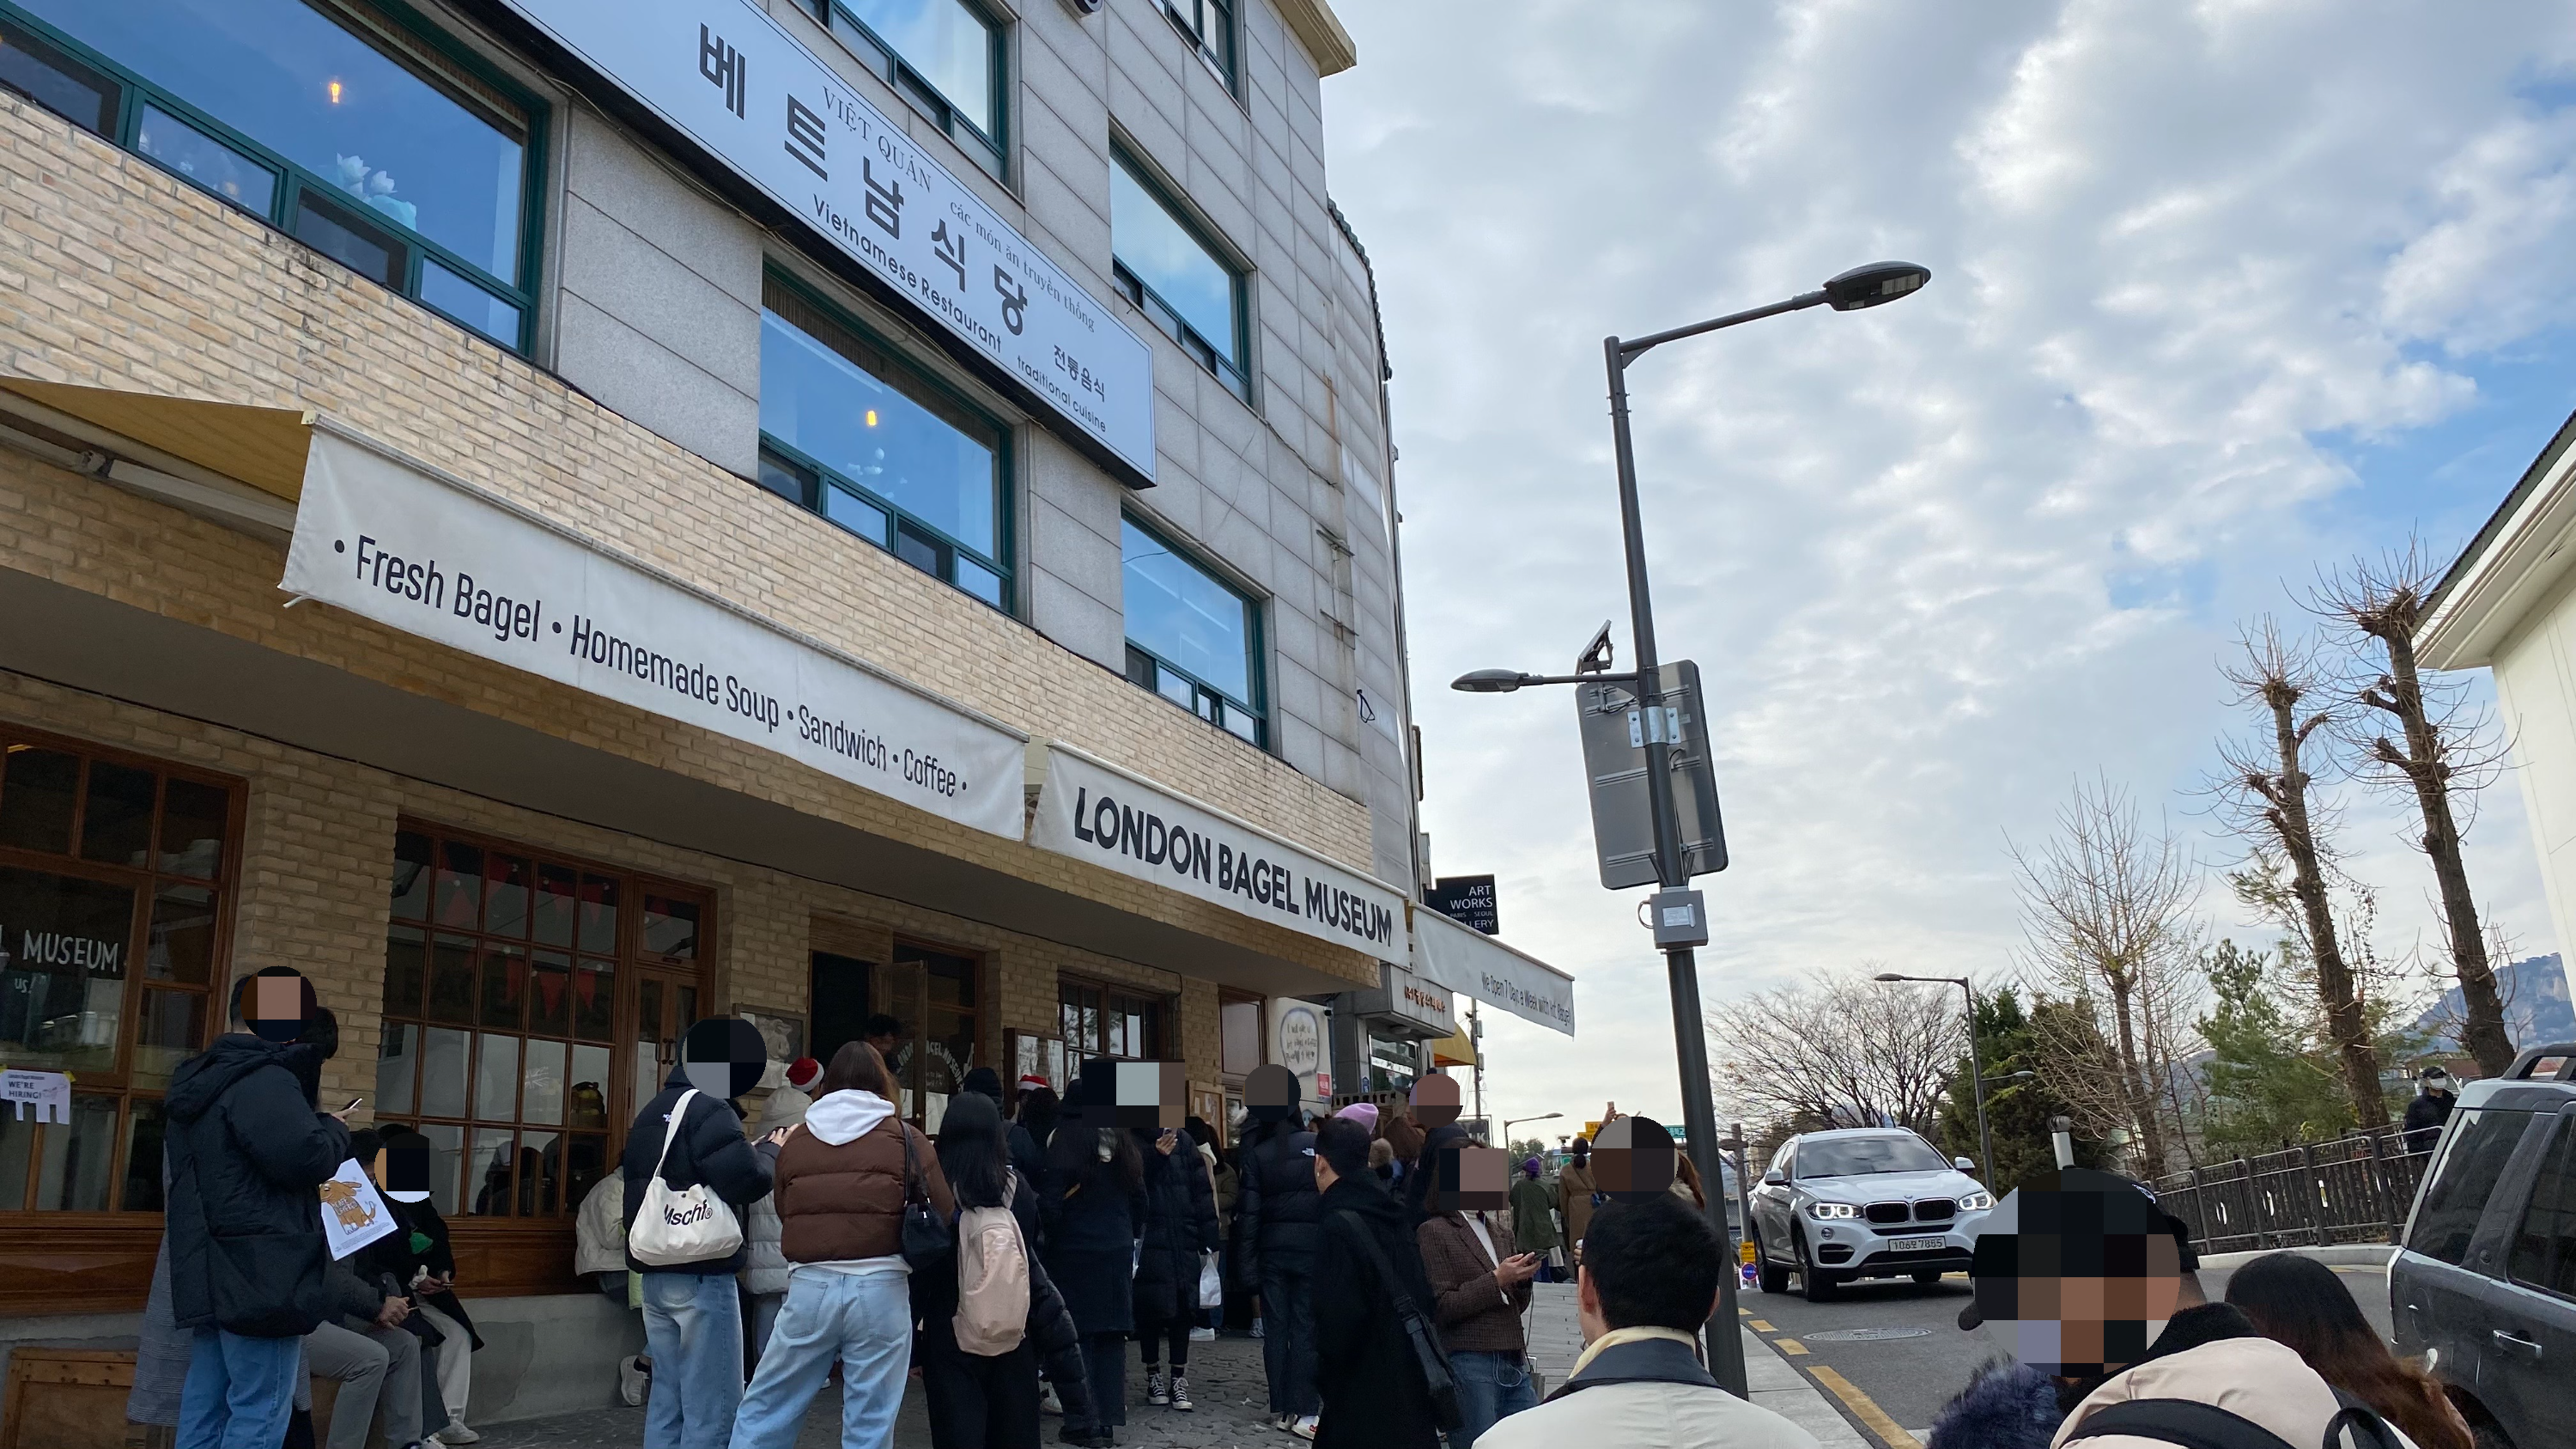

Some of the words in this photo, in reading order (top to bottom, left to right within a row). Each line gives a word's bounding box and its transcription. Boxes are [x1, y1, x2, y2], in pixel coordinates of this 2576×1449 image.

[950, 201, 971, 226] các
[975, 222, 1001, 253] món
[813, 193, 917, 288] Vietnamese
[921, 277, 1001, 353] Restaurant
[1018, 355, 1071, 406] traditional
[1072, 400, 1106, 432] cuisine
[1054, 344, 1104, 403] 전통음식
[356, 534, 444, 609] Fresh
[453, 572, 541, 642] Bagel
[569, 614, 719, 705] Homemade
[726, 675, 780, 733] Soup
[799, 704, 887, 771] Sandwich
[903, 748, 956, 797] Coffee
[1074, 786, 1212, 885] LONDON
[1218, 842, 1300, 916] BAGEL
[1304, 876, 1392, 948] MUSEUM
[1468, 885, 1492, 897] ART
[1449, 898, 1493, 910] WORKS
[22, 928, 118, 972] MUSEUM
[1480, 971, 1491, 992] We
[1491, 975, 1504, 999] Open
[1504, 979, 1508, 998] 7
[1509, 982, 1520, 1007] Days
[1520, 991, 1524, 1006] a
[1524, 989, 1538, 1011] Week
[1538, 996, 1550, 1015] with
[9, 1090, 42, 1099] HIRING!
